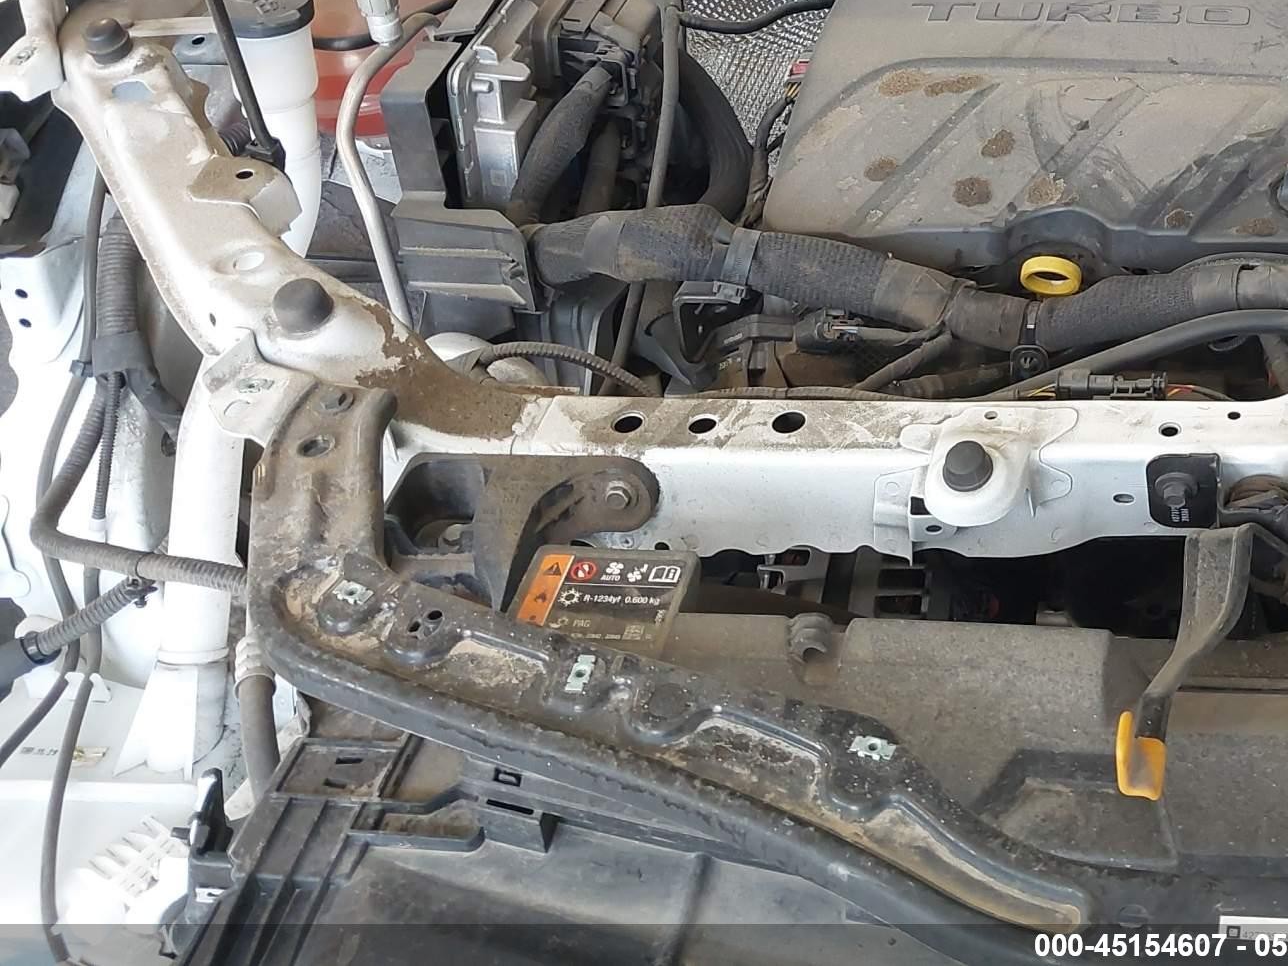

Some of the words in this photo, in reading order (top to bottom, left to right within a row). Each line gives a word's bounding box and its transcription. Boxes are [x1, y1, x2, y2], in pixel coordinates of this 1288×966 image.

[911, 1, 1251, 26] TURBO
[600, 574, 621, 582] AUTO
[583, 594, 622, 604] R-1234yf
[624, 595, 648, 604] 0.600
[648, 596, 661, 606] kg
[572, 619, 591, 628] PAG
